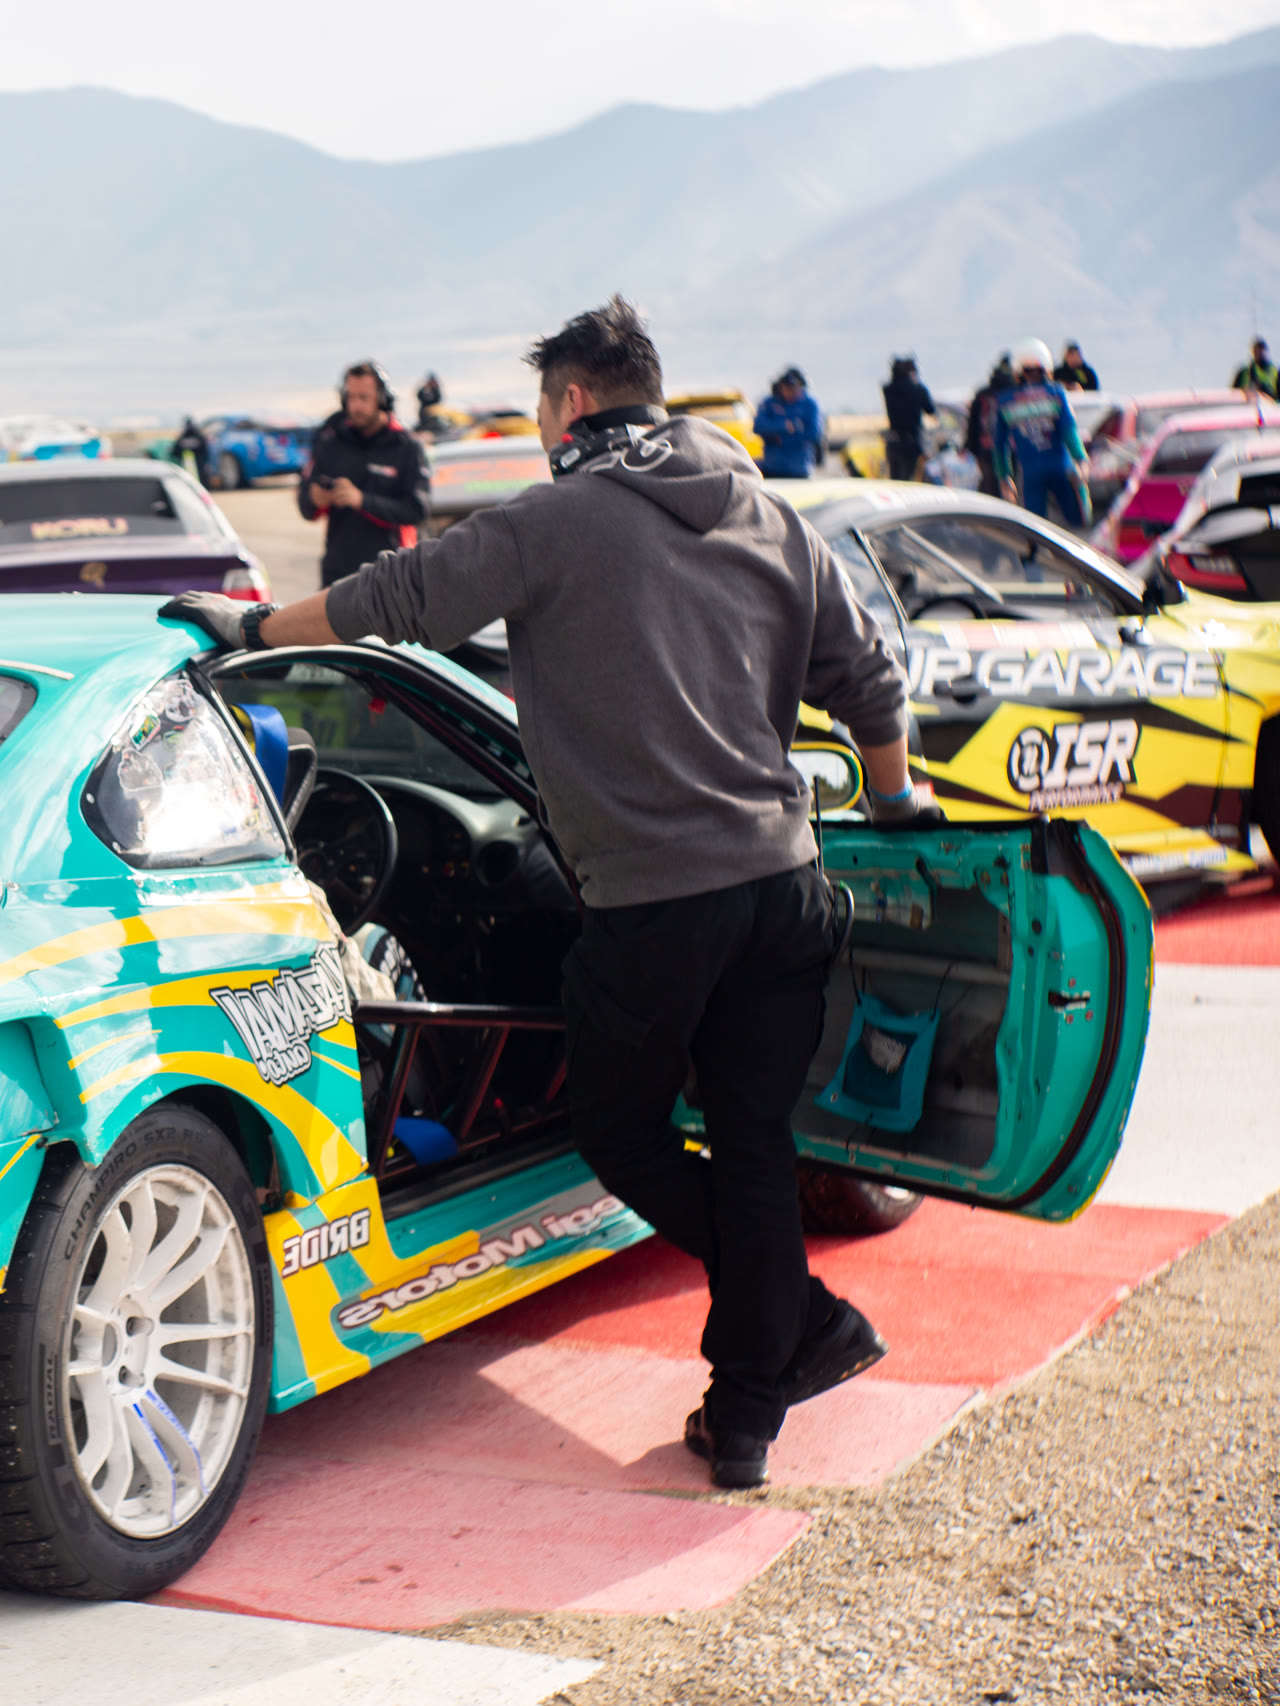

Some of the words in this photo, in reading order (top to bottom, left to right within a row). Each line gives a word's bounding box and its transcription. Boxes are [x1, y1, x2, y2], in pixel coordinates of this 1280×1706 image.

[977, 648, 1222, 698] GARAGE
[1050, 719, 1139, 787] ISR
[63, 1142, 138, 1262] CHAMPIRO
